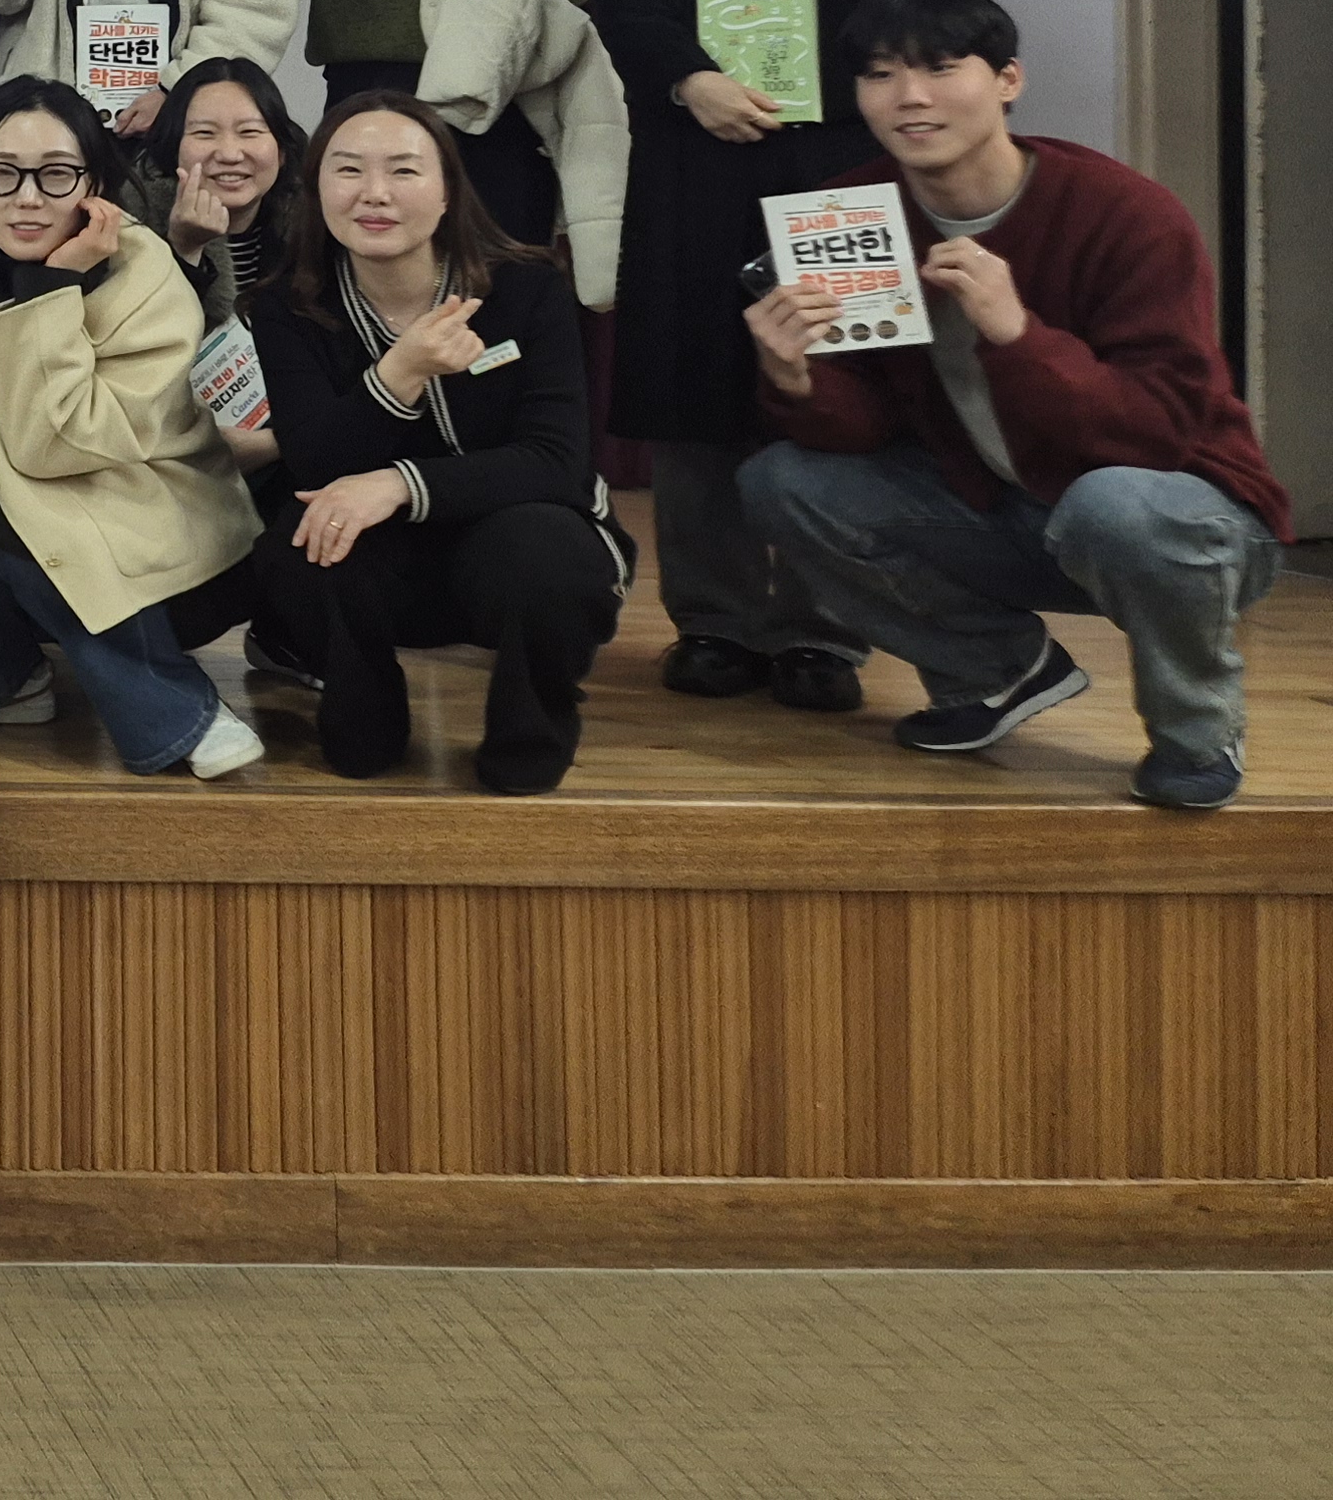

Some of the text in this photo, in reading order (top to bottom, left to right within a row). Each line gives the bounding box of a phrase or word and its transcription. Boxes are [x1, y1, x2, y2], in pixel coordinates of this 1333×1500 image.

[89, 24, 160, 37] 교사를 지키는
[89, 39, 160, 65] 단단한
[88, 67, 159, 88] 학급경영
[785, 210, 887, 235] 교사를 지키는
[791, 226, 895, 265] 단단한
[231, 390, 261, 418] Canva
